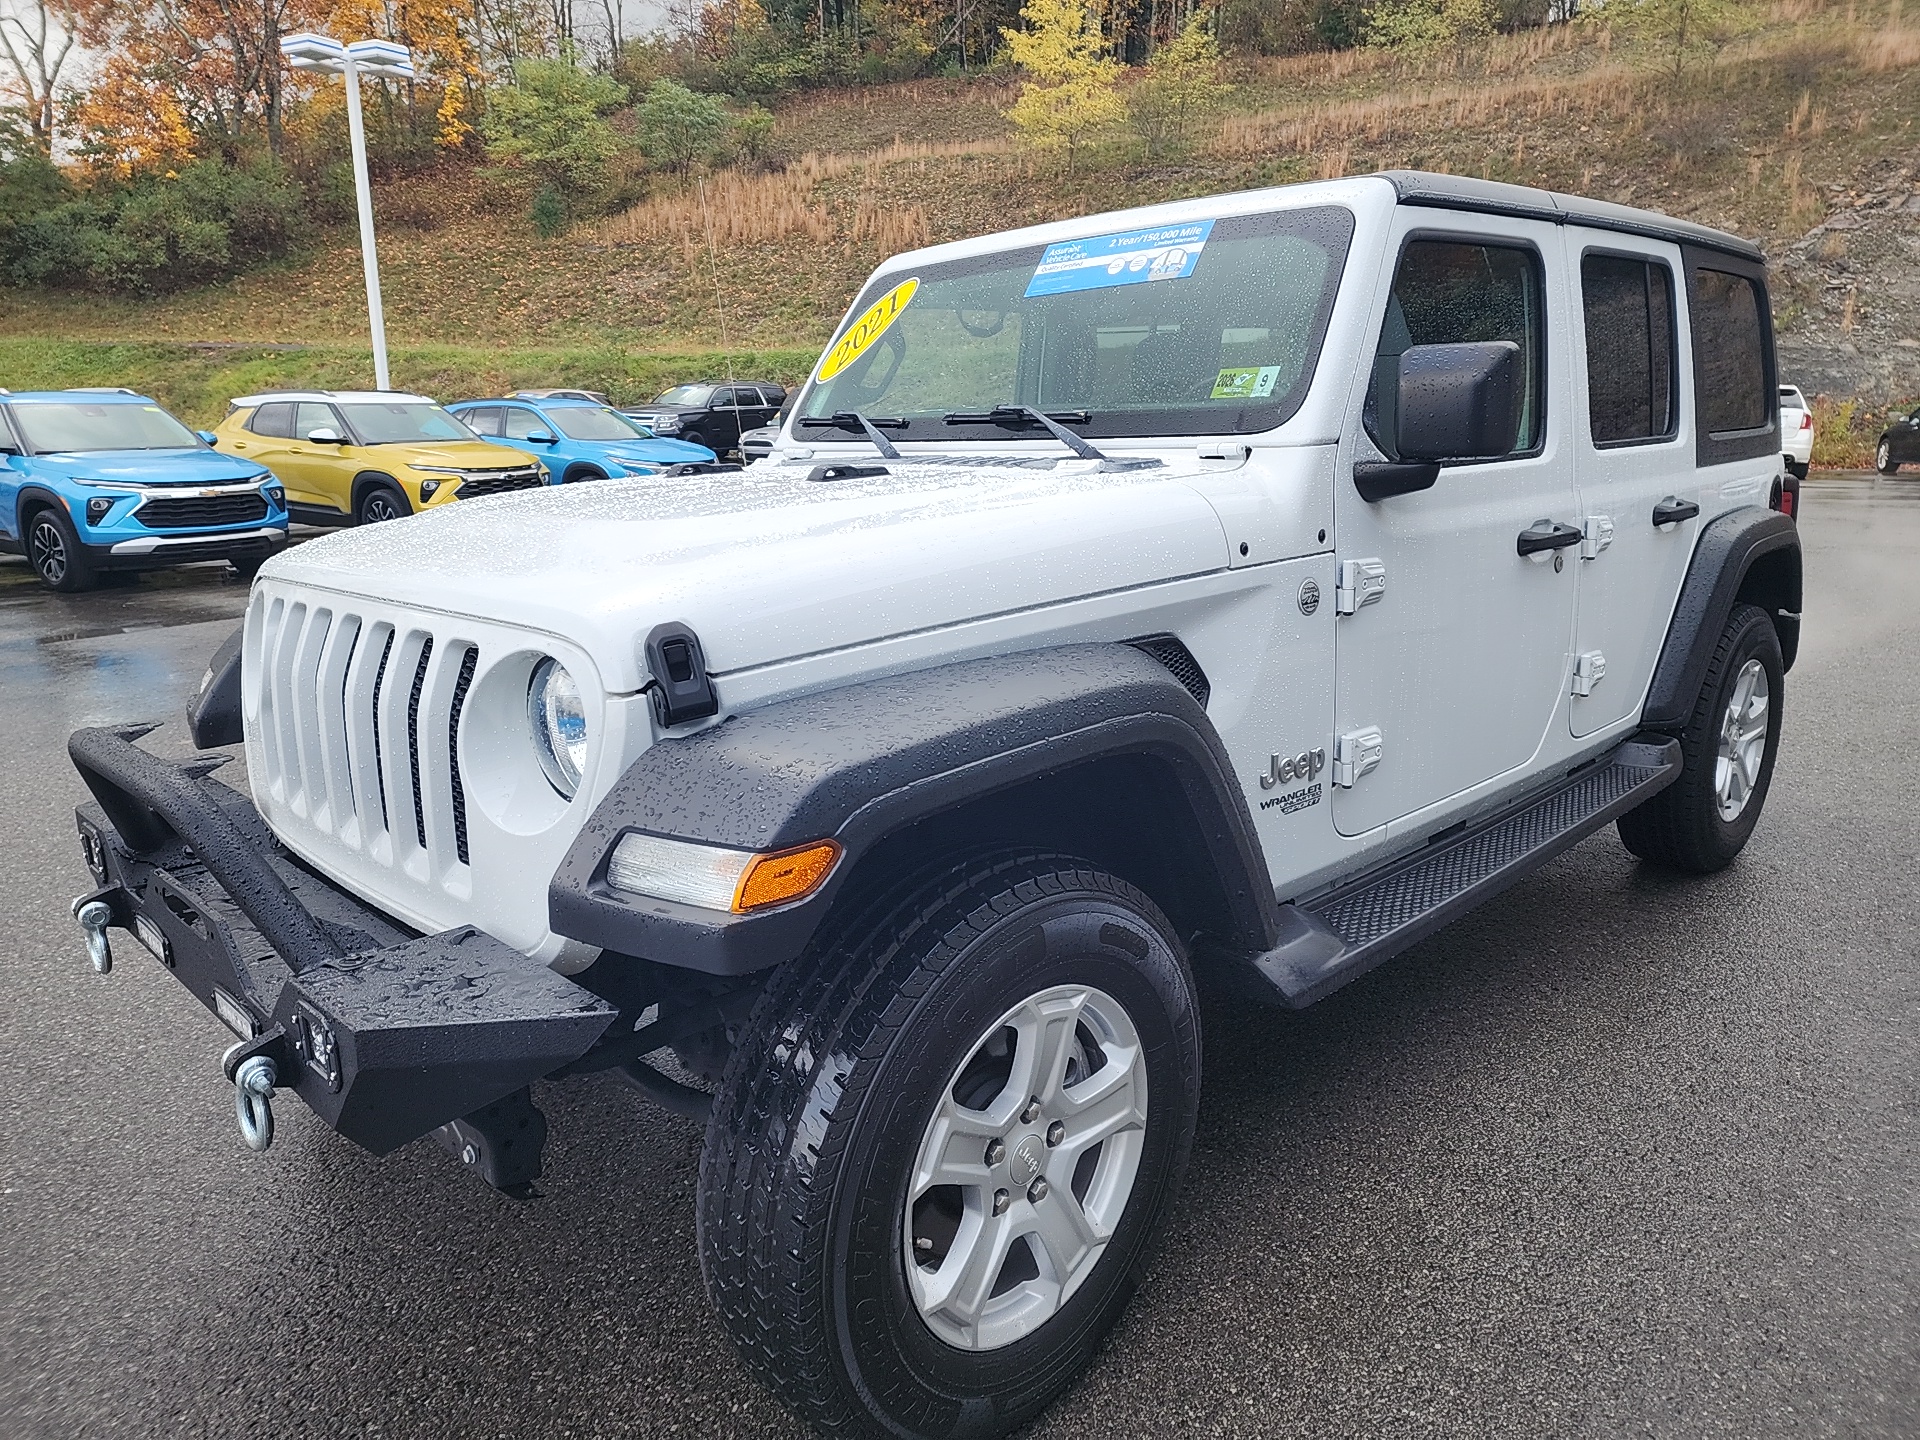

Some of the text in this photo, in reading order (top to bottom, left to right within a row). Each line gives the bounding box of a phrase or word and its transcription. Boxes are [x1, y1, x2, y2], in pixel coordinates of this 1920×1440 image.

[1109, 226, 1203, 248] 2 Year/150,000 Mile
[1070, 251, 1087, 260] Care
[836, 290, 899, 371] 2021
[1260, 374, 1269, 387] 9
[1260, 747, 1325, 790] Jeep
[1260, 783, 1322, 810] WRANGLER
[1019, 1147, 1038, 1173] Jeep
